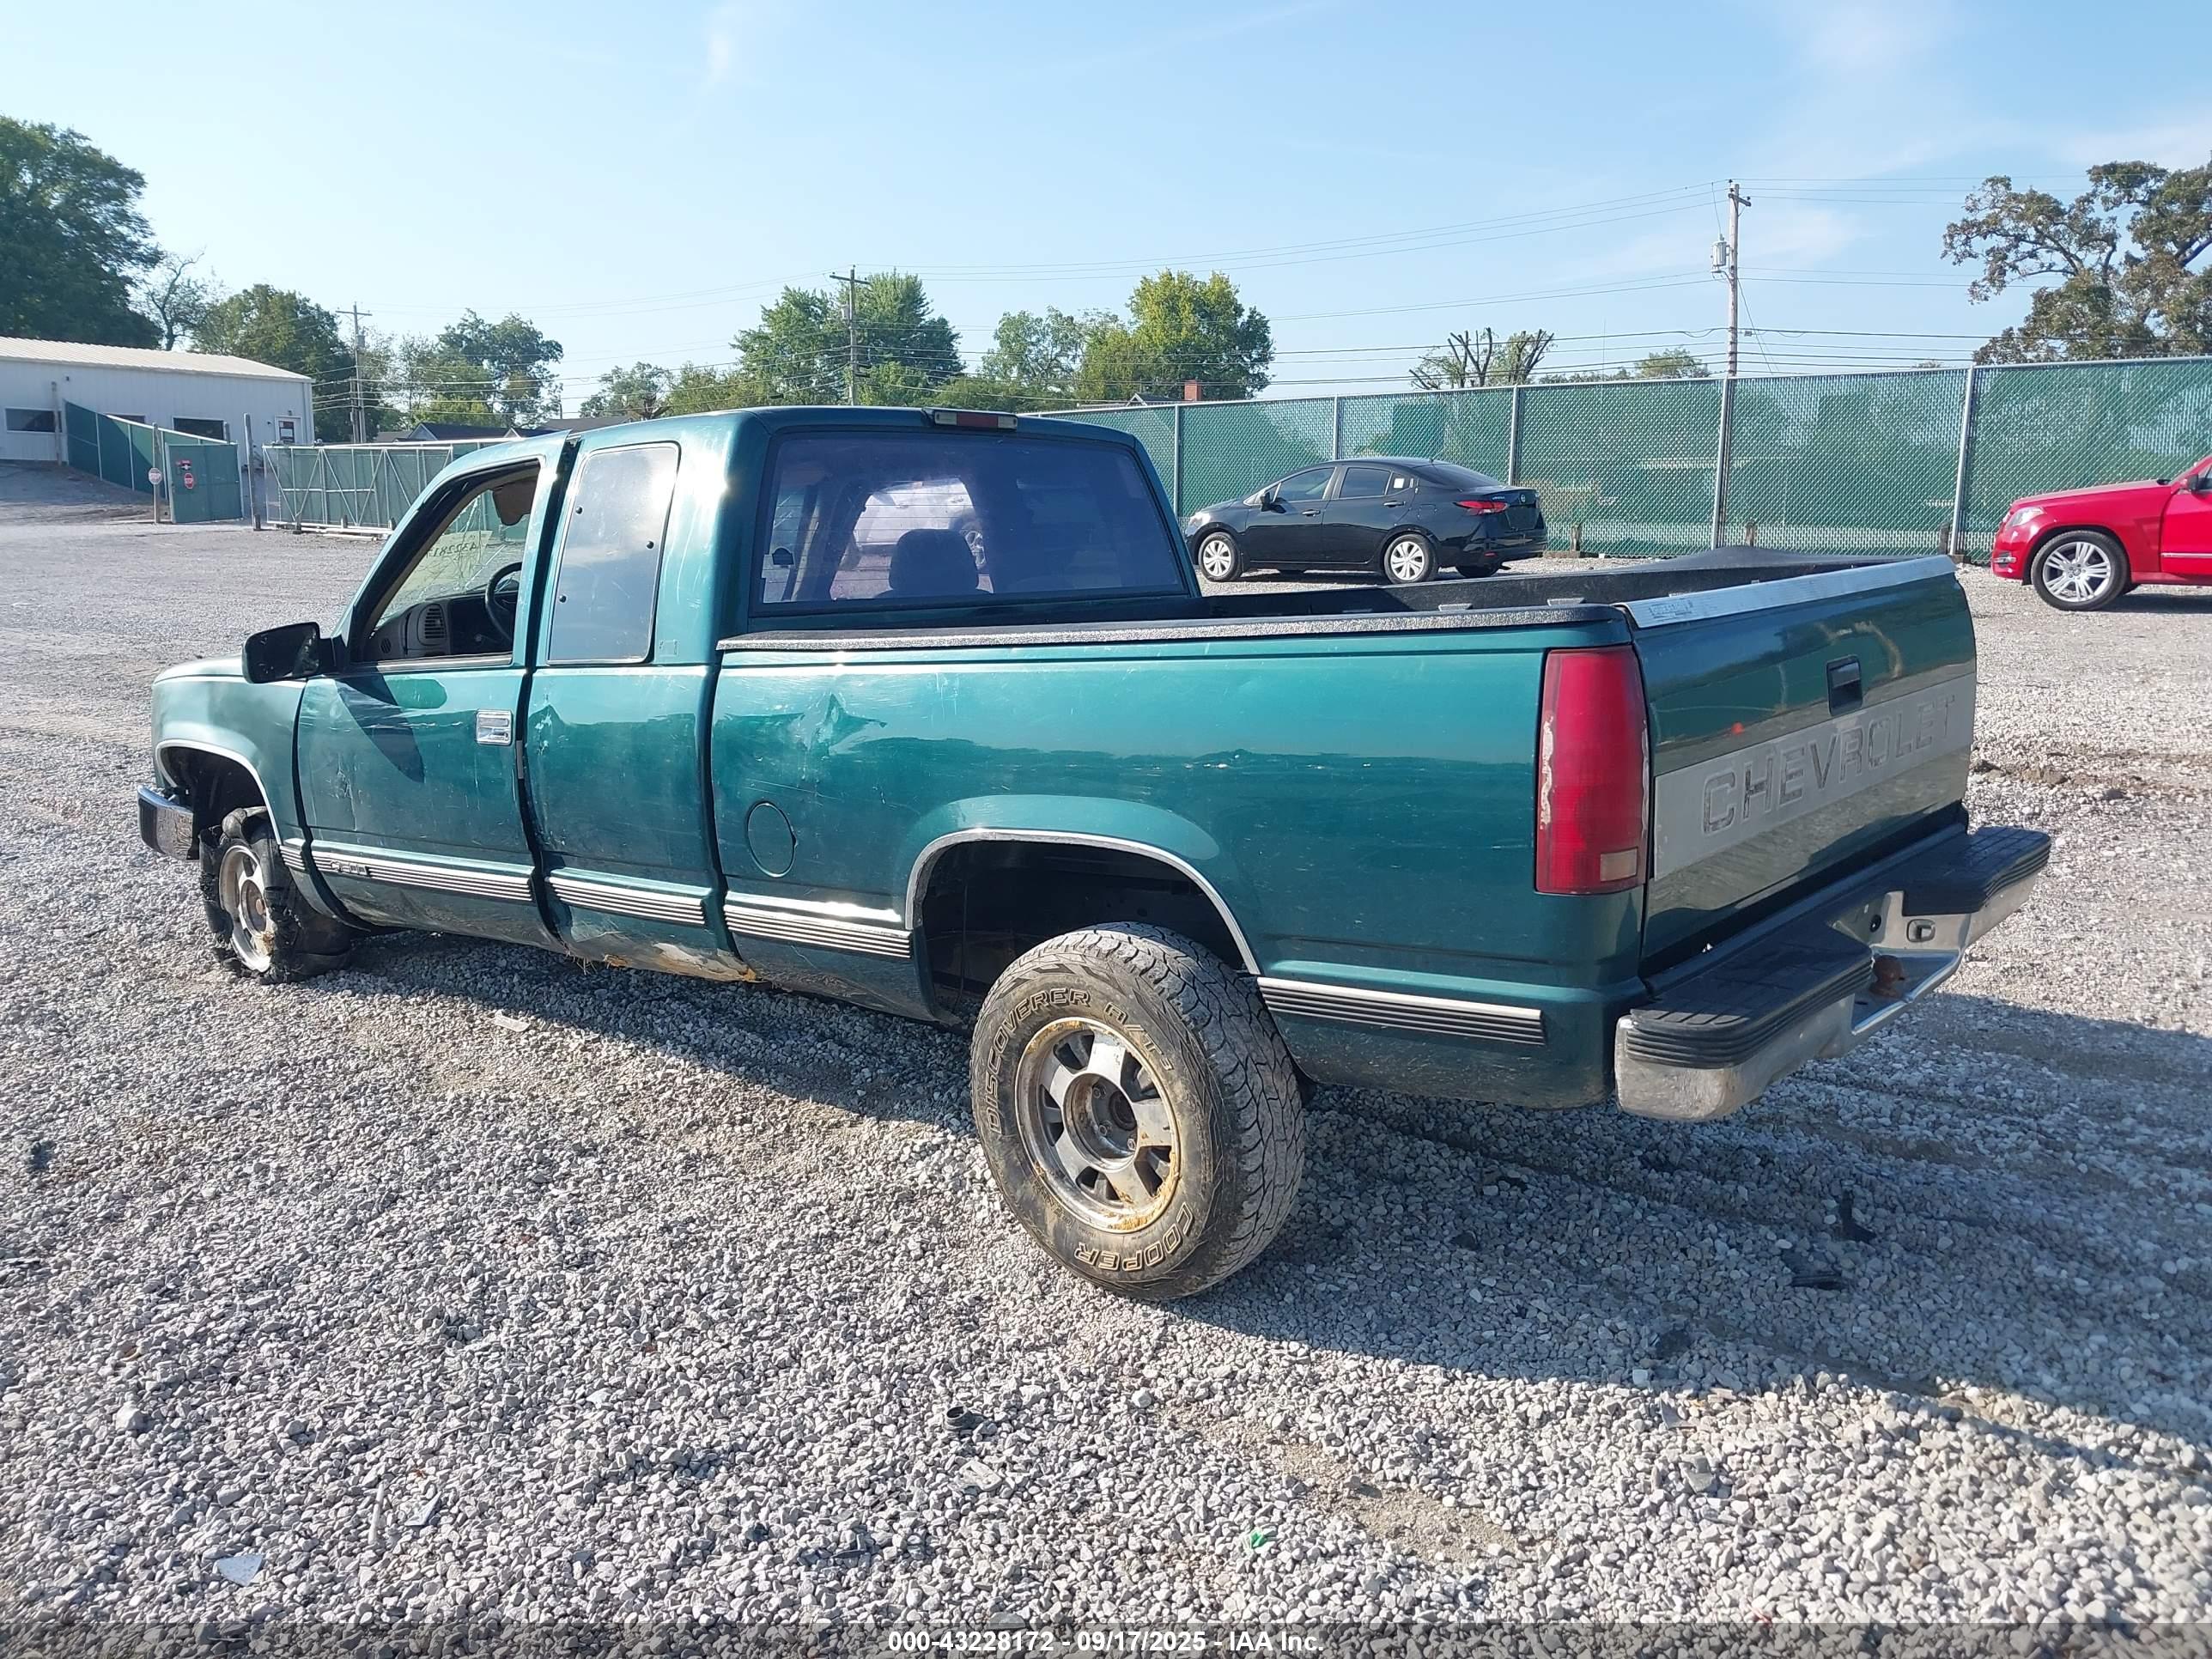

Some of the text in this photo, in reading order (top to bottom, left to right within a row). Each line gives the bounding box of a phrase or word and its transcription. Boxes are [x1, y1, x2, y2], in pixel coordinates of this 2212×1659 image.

[1703, 694, 1955, 835] CHEVROLET
[985, 988, 1091, 1134] DISCOVERER
[1074, 1202, 1194, 1272] COOPER
